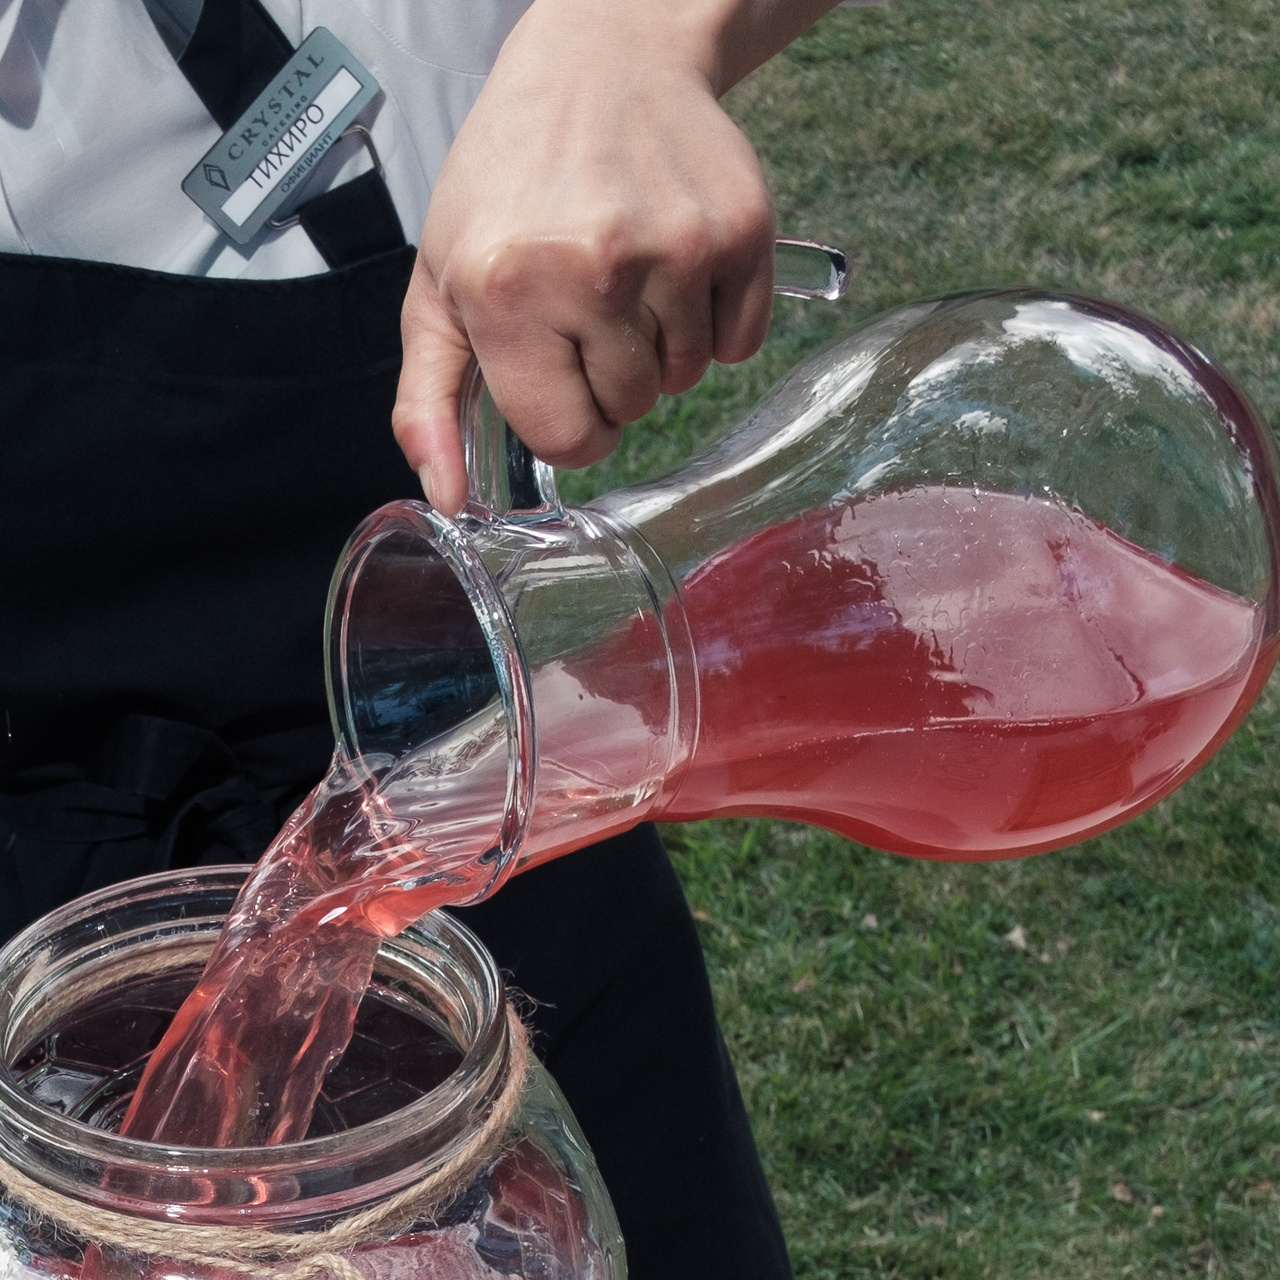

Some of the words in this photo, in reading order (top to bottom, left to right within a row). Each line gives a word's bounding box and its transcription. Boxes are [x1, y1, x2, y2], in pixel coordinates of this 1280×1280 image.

[228, 54, 325, 162] CRYSTAL
[261, 94, 308, 148] CATERING
[244, 103, 324, 189] ТИХИРО
[281, 131, 334, 193] ОФИЦИАНТ
